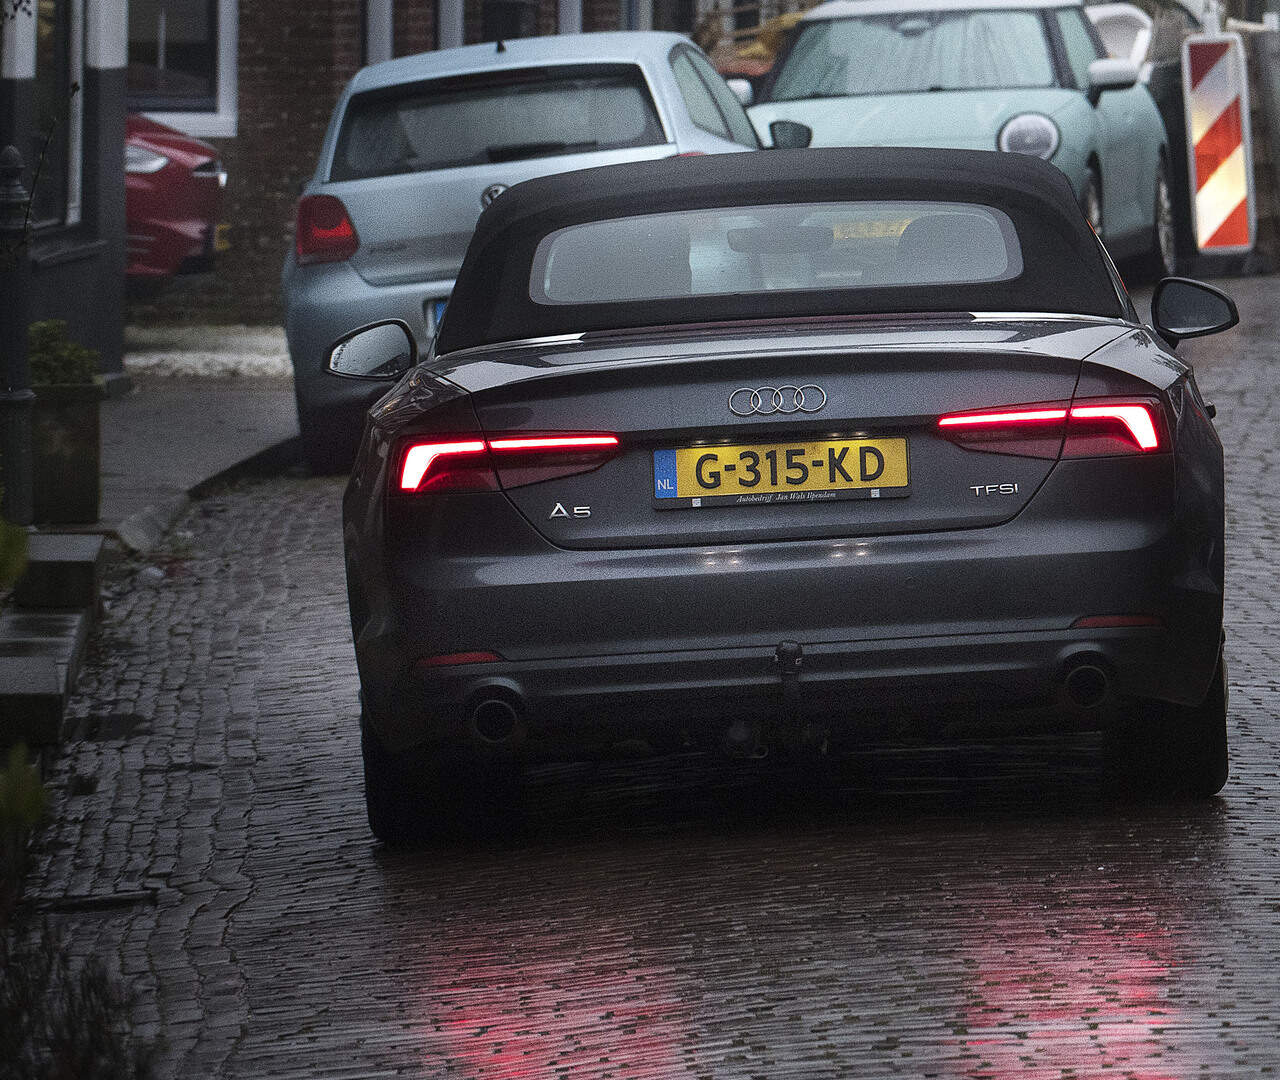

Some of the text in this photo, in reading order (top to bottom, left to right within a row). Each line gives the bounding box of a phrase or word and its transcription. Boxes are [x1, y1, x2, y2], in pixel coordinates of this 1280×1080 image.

[695, 446, 885, 490] G-315-KD
[657, 479, 674, 490] NL
[969, 483, 1018, 497] TFSI
[549, 502, 591, 520] A5
